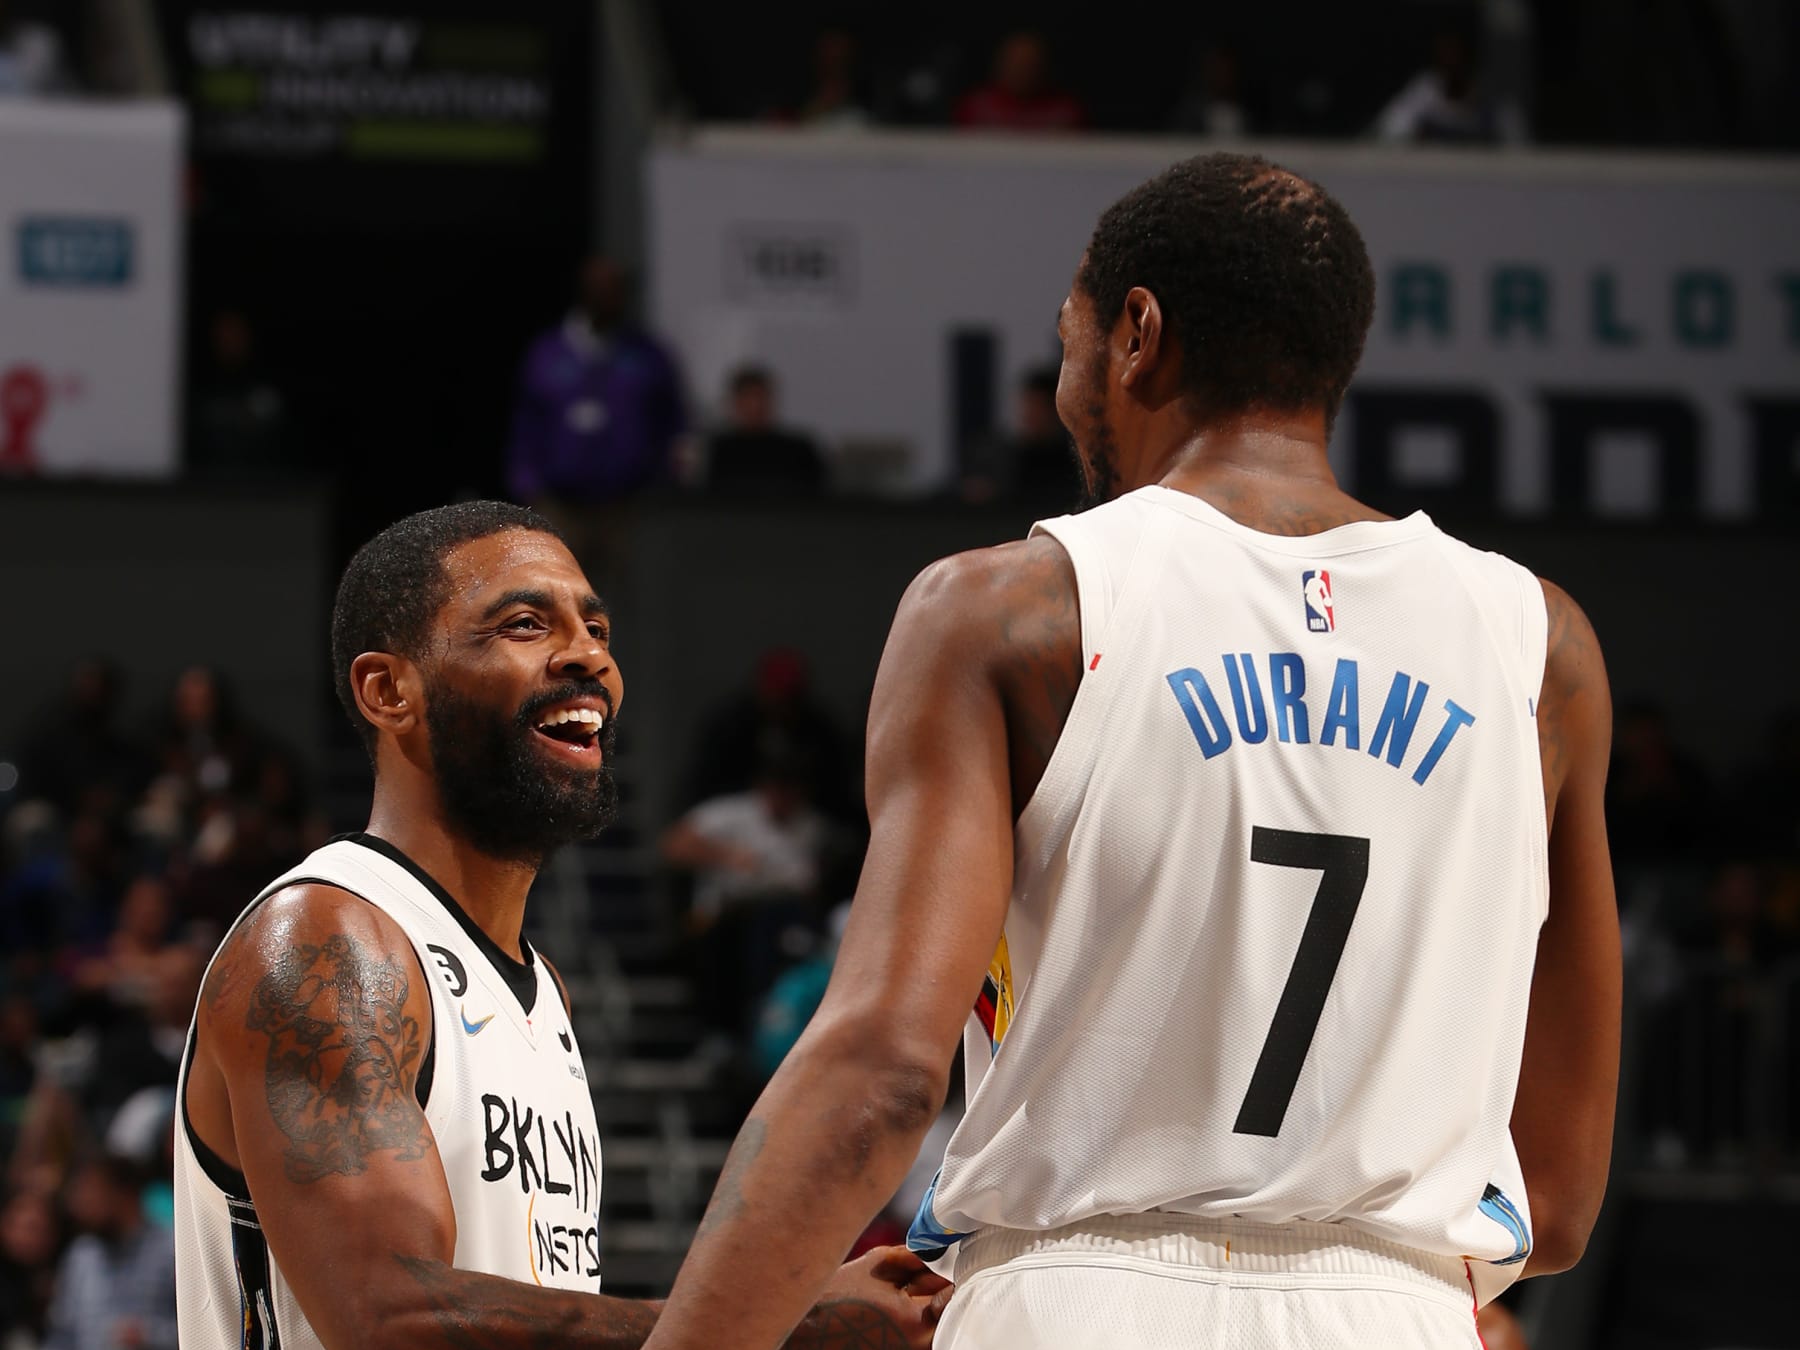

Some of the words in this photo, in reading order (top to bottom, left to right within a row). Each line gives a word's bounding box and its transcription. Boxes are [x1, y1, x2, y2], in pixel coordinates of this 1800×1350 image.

[187, 13, 420, 66] UTILITY
[1166, 652, 1477, 788] DURANT
[1232, 826, 1370, 1138] 7
[480, 1093, 599, 1214] BKLYN
[533, 1218, 601, 1278] NETS
